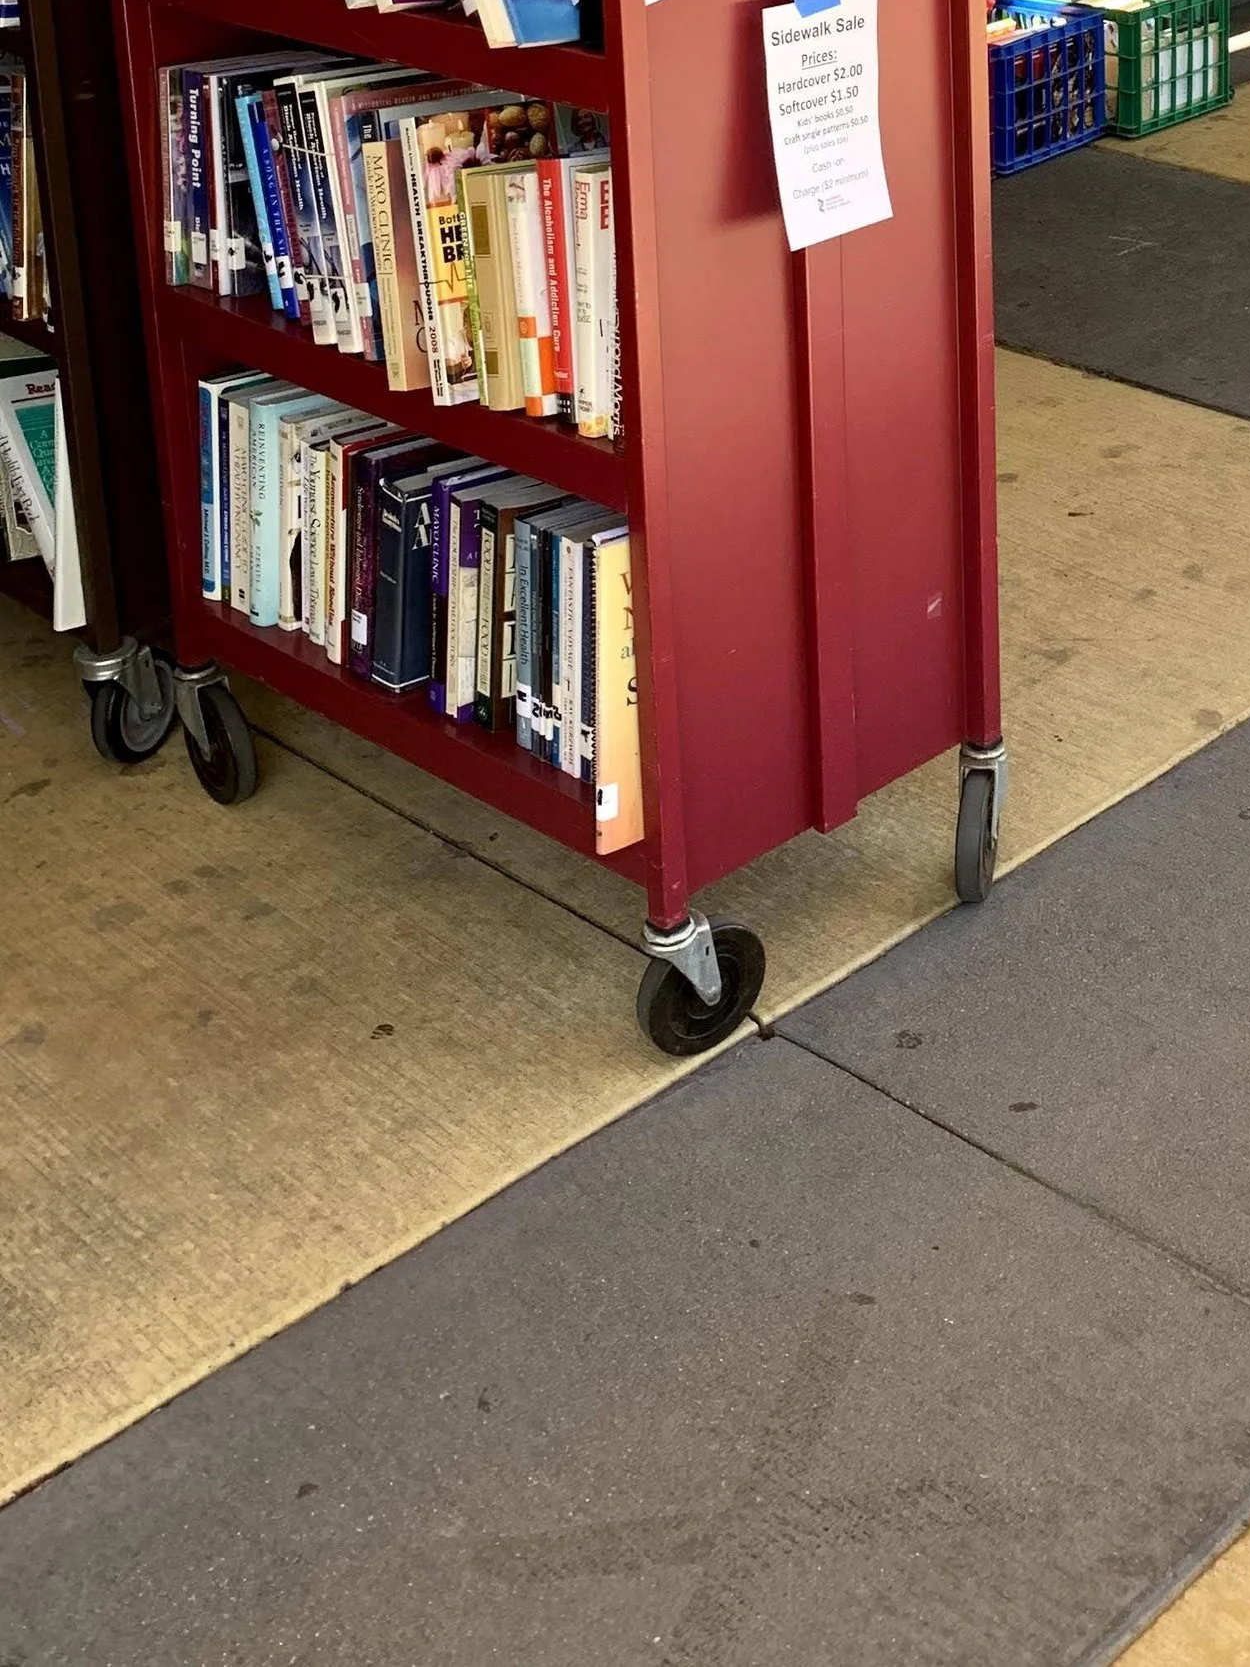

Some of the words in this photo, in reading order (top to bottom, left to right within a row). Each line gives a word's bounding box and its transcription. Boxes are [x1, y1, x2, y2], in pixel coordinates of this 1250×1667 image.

[771, 21, 832, 47] Sidewalk
[836, 15, 865, 33] Sale
[801, 49, 838, 68] Prices:
[778, 73, 831, 95] Hardcover
[833, 63, 863, 82] $2.00
[188, 88, 201, 144] Turning
[779, 95, 828, 117] Softcover
[831, 85, 859, 104] $1.50
[815, 111, 835, 123] books
[835, 105, 854, 118] $0.50
[362, 124, 372, 139] The
[784, 134, 801, 146] Craft
[802, 129, 821, 141] single
[822, 122, 850, 136] patterns
[191, 148, 202, 187] Point
[264, 159, 275, 189] SONG
[365, 155, 374, 181] Guide
[372, 155, 388, 206] MAYO
[812, 161, 832, 173] Cash
[270, 194, 278, 206] IN
[543, 178, 552, 197] The
[793, 185, 820, 199] Charge
[273, 211, 282, 232] THE
[544, 199, 555, 255] Alcoholism
[378, 210, 393, 271] CLINIC
[459, 211, 470, 247] GREEN
[465, 267, 474, 289] LIFE
[411, 173, 421, 216] HEALTH
[416, 220, 433, 320] BREAKTHROUGHS
[429, 326, 439, 353] 2008
[548, 258, 558, 278] and
[550, 280, 561, 326] Addiction
[553, 330, 561, 352] Cure
[258, 423, 266, 500] REINVENTING
[308, 469, 321, 515] Youngest
[356, 486, 364, 530] Syndromes
[309, 517, 321, 558] Science
[355, 532, 363, 546] and
[432, 506, 440, 542] MAYO
[431, 542, 440, 583] CLINIC
[519, 565, 528, 575] In
[519, 578, 530, 627] Excellent
[519, 629, 530, 665] Health
